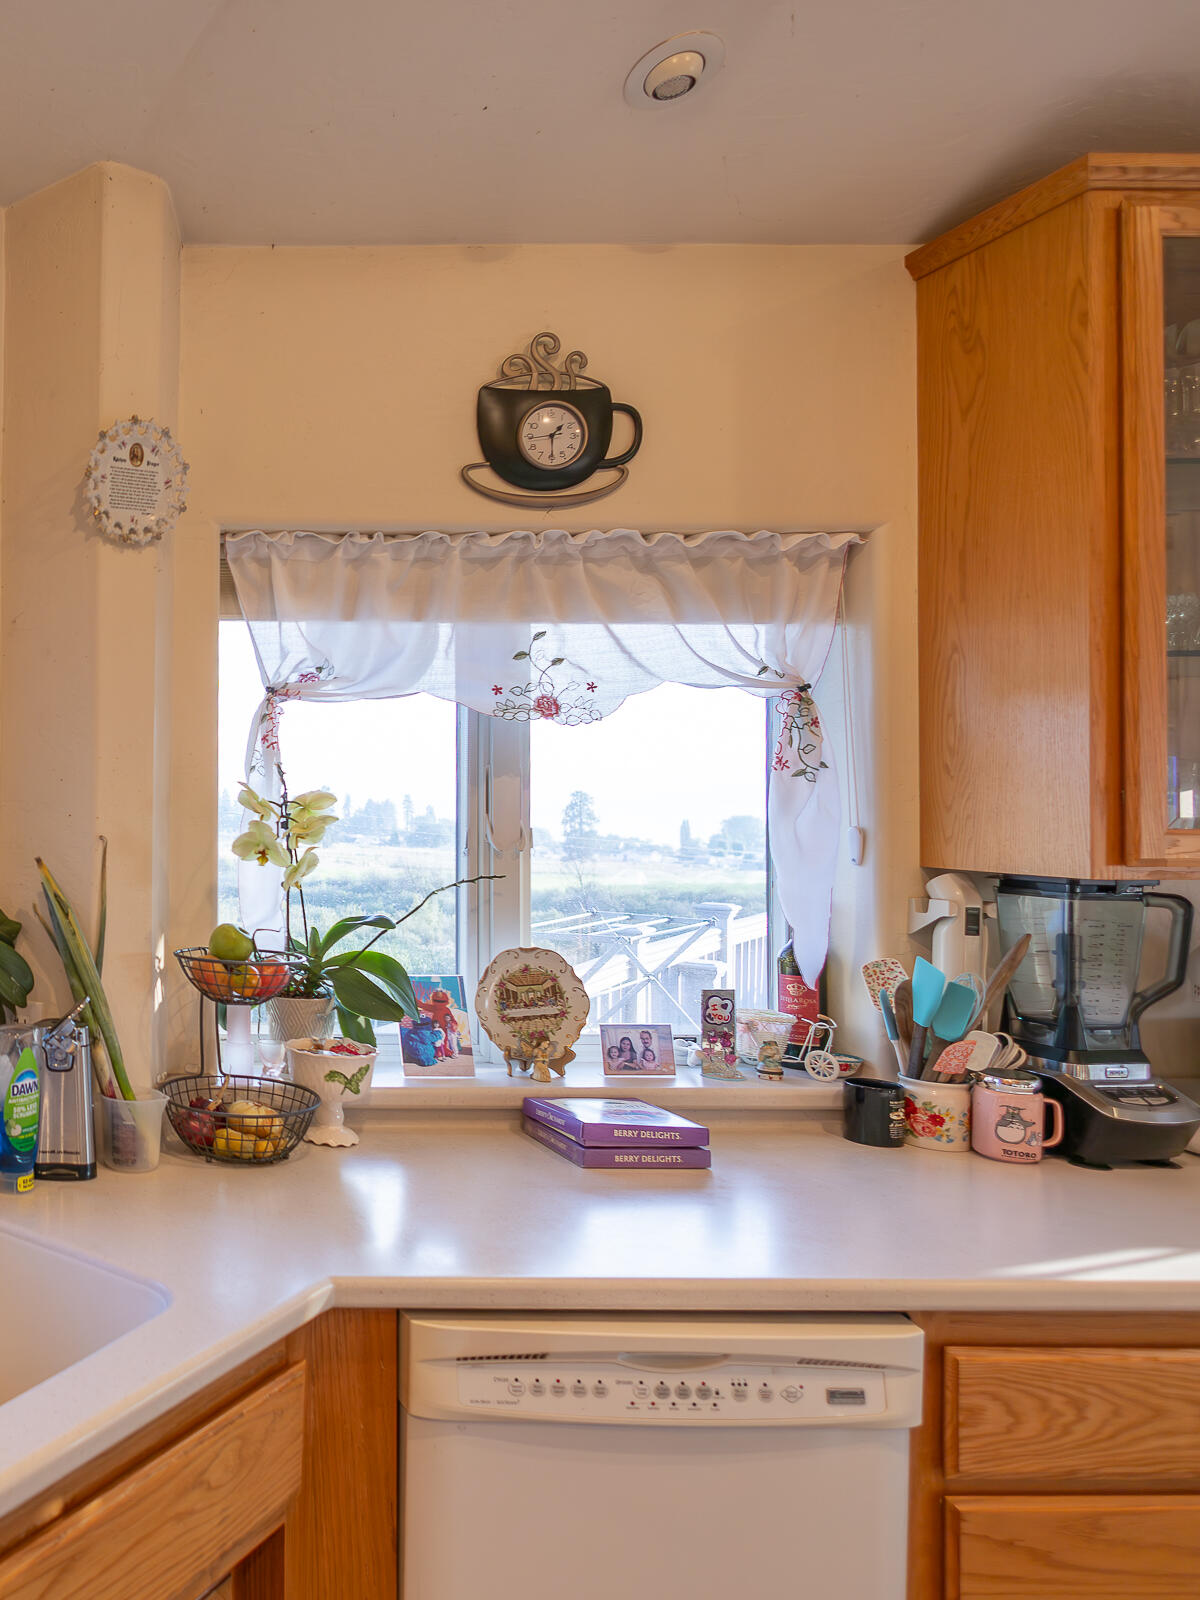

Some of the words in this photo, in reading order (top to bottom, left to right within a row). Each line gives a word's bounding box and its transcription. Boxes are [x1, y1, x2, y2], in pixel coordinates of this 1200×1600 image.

[711, 1013, 730, 1022] YOU
[11, 1080, 38, 1096] DAWN
[613, 1129, 639, 1138] BERRY
[1001, 1148, 1037, 1159] TOTORO
[614, 1155, 640, 1163] BERRY
